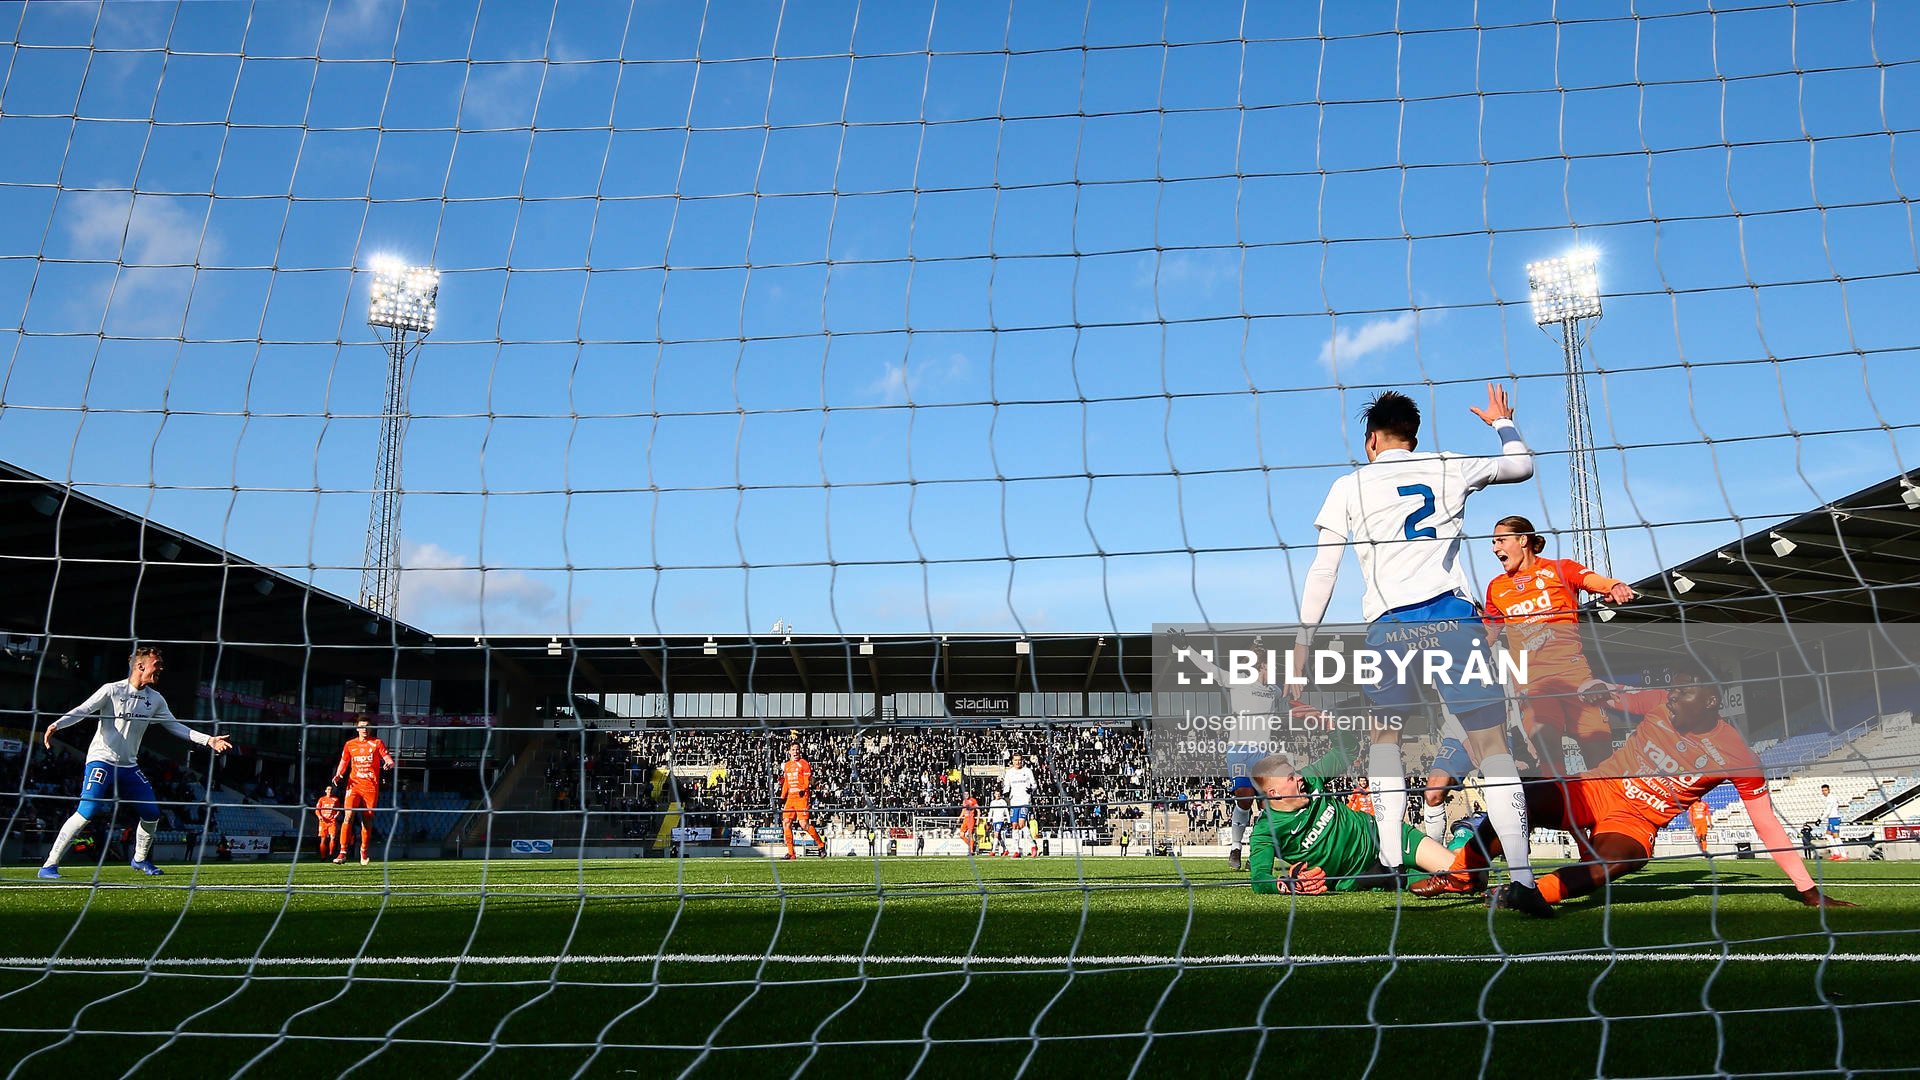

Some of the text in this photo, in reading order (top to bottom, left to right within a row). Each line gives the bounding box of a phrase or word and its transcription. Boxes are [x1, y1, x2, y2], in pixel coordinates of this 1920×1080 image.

[1397, 483, 1437, 540] 2
[1386, 620, 1459, 643] MÅNSSON
[1408, 637, 1440, 651] RÖR
[955, 698, 1008, 709] stadium
[1643, 740, 1703, 787] rapid
[1301, 803, 1336, 849] HOLMEN
